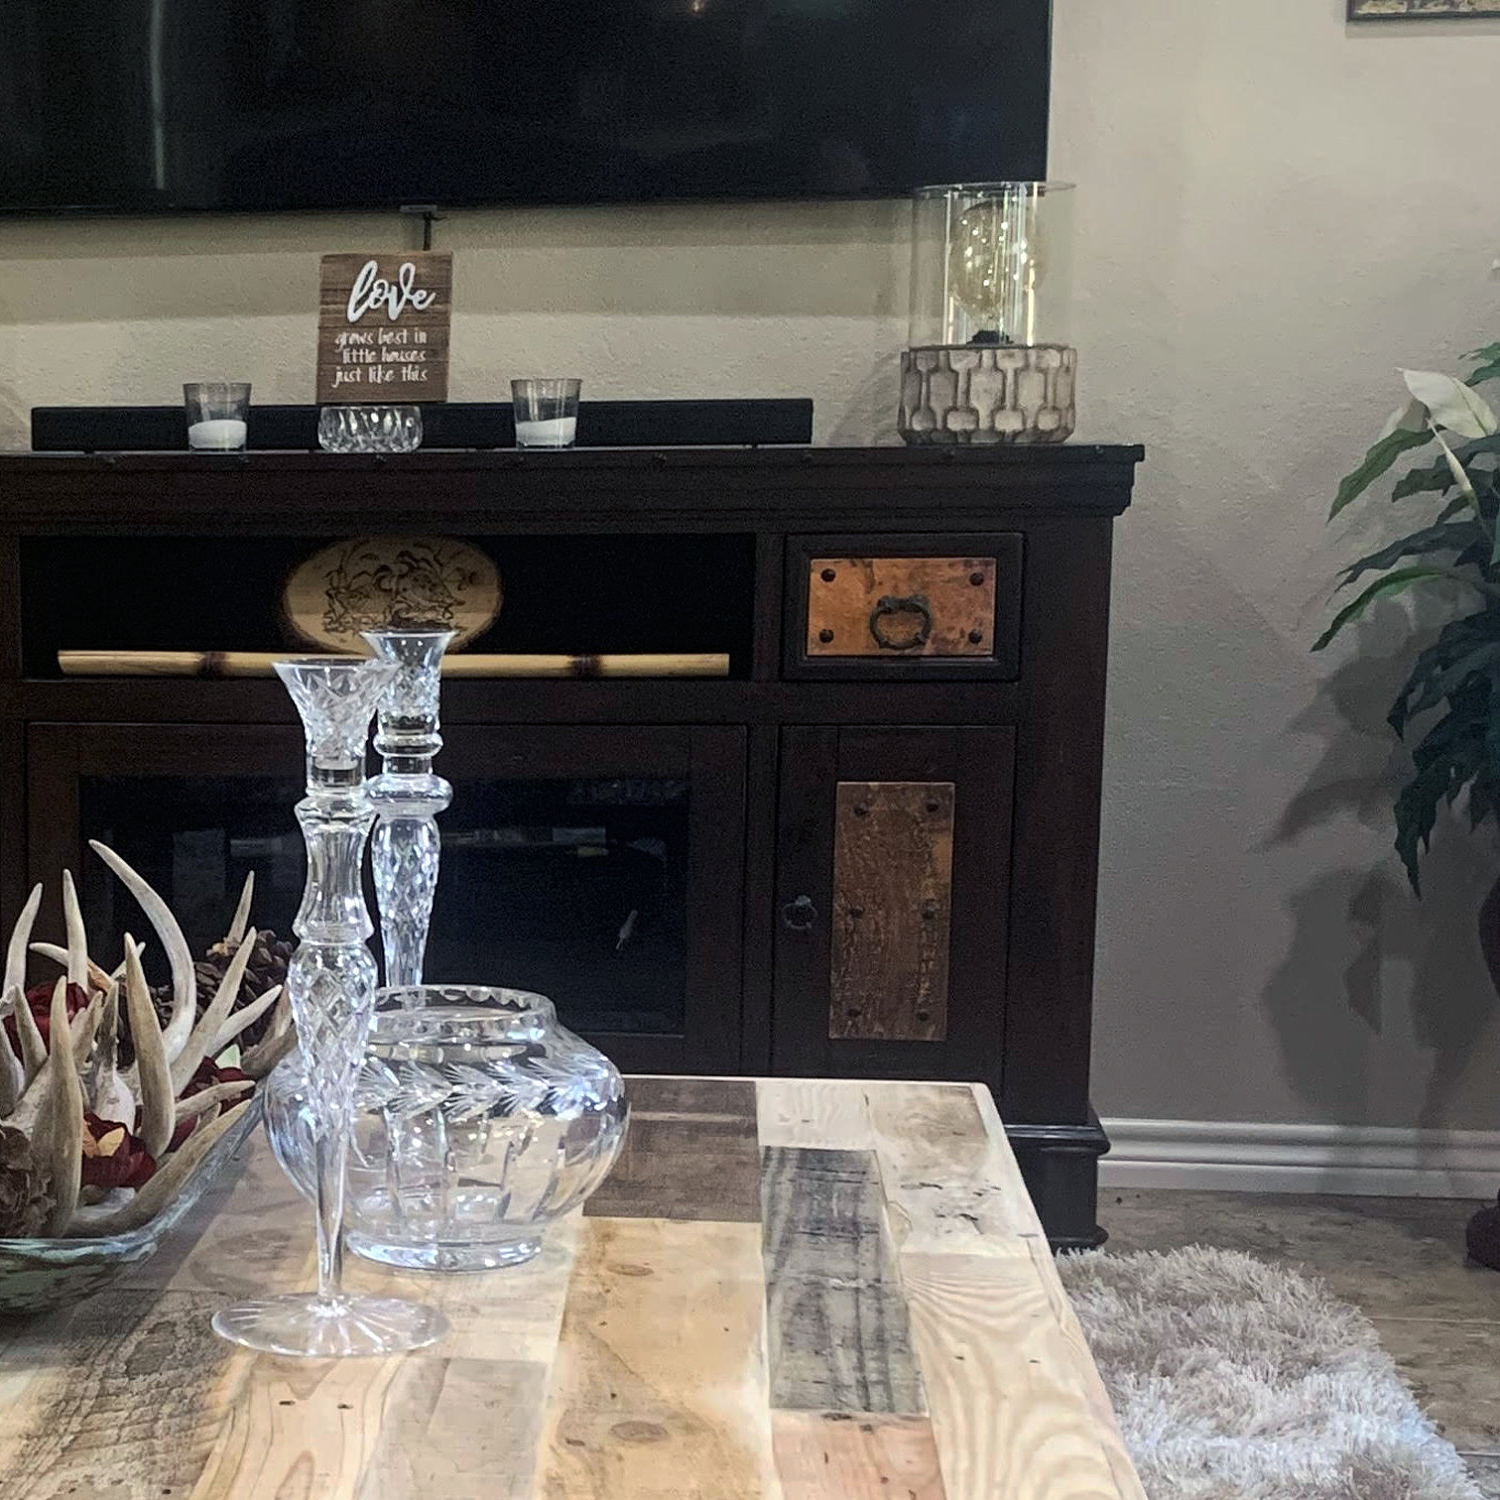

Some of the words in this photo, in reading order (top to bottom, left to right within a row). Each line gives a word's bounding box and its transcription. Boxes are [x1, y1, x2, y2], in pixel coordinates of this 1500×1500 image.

[334, 331, 374, 353] grows
[378, 327, 407, 345] best
[414, 327, 427, 344] in
[342, 347, 377, 364] little
[382, 346, 427, 362] houses
[331, 366, 361, 388] just
[368, 364, 395, 384] like
[401, 364, 429, 382] this
